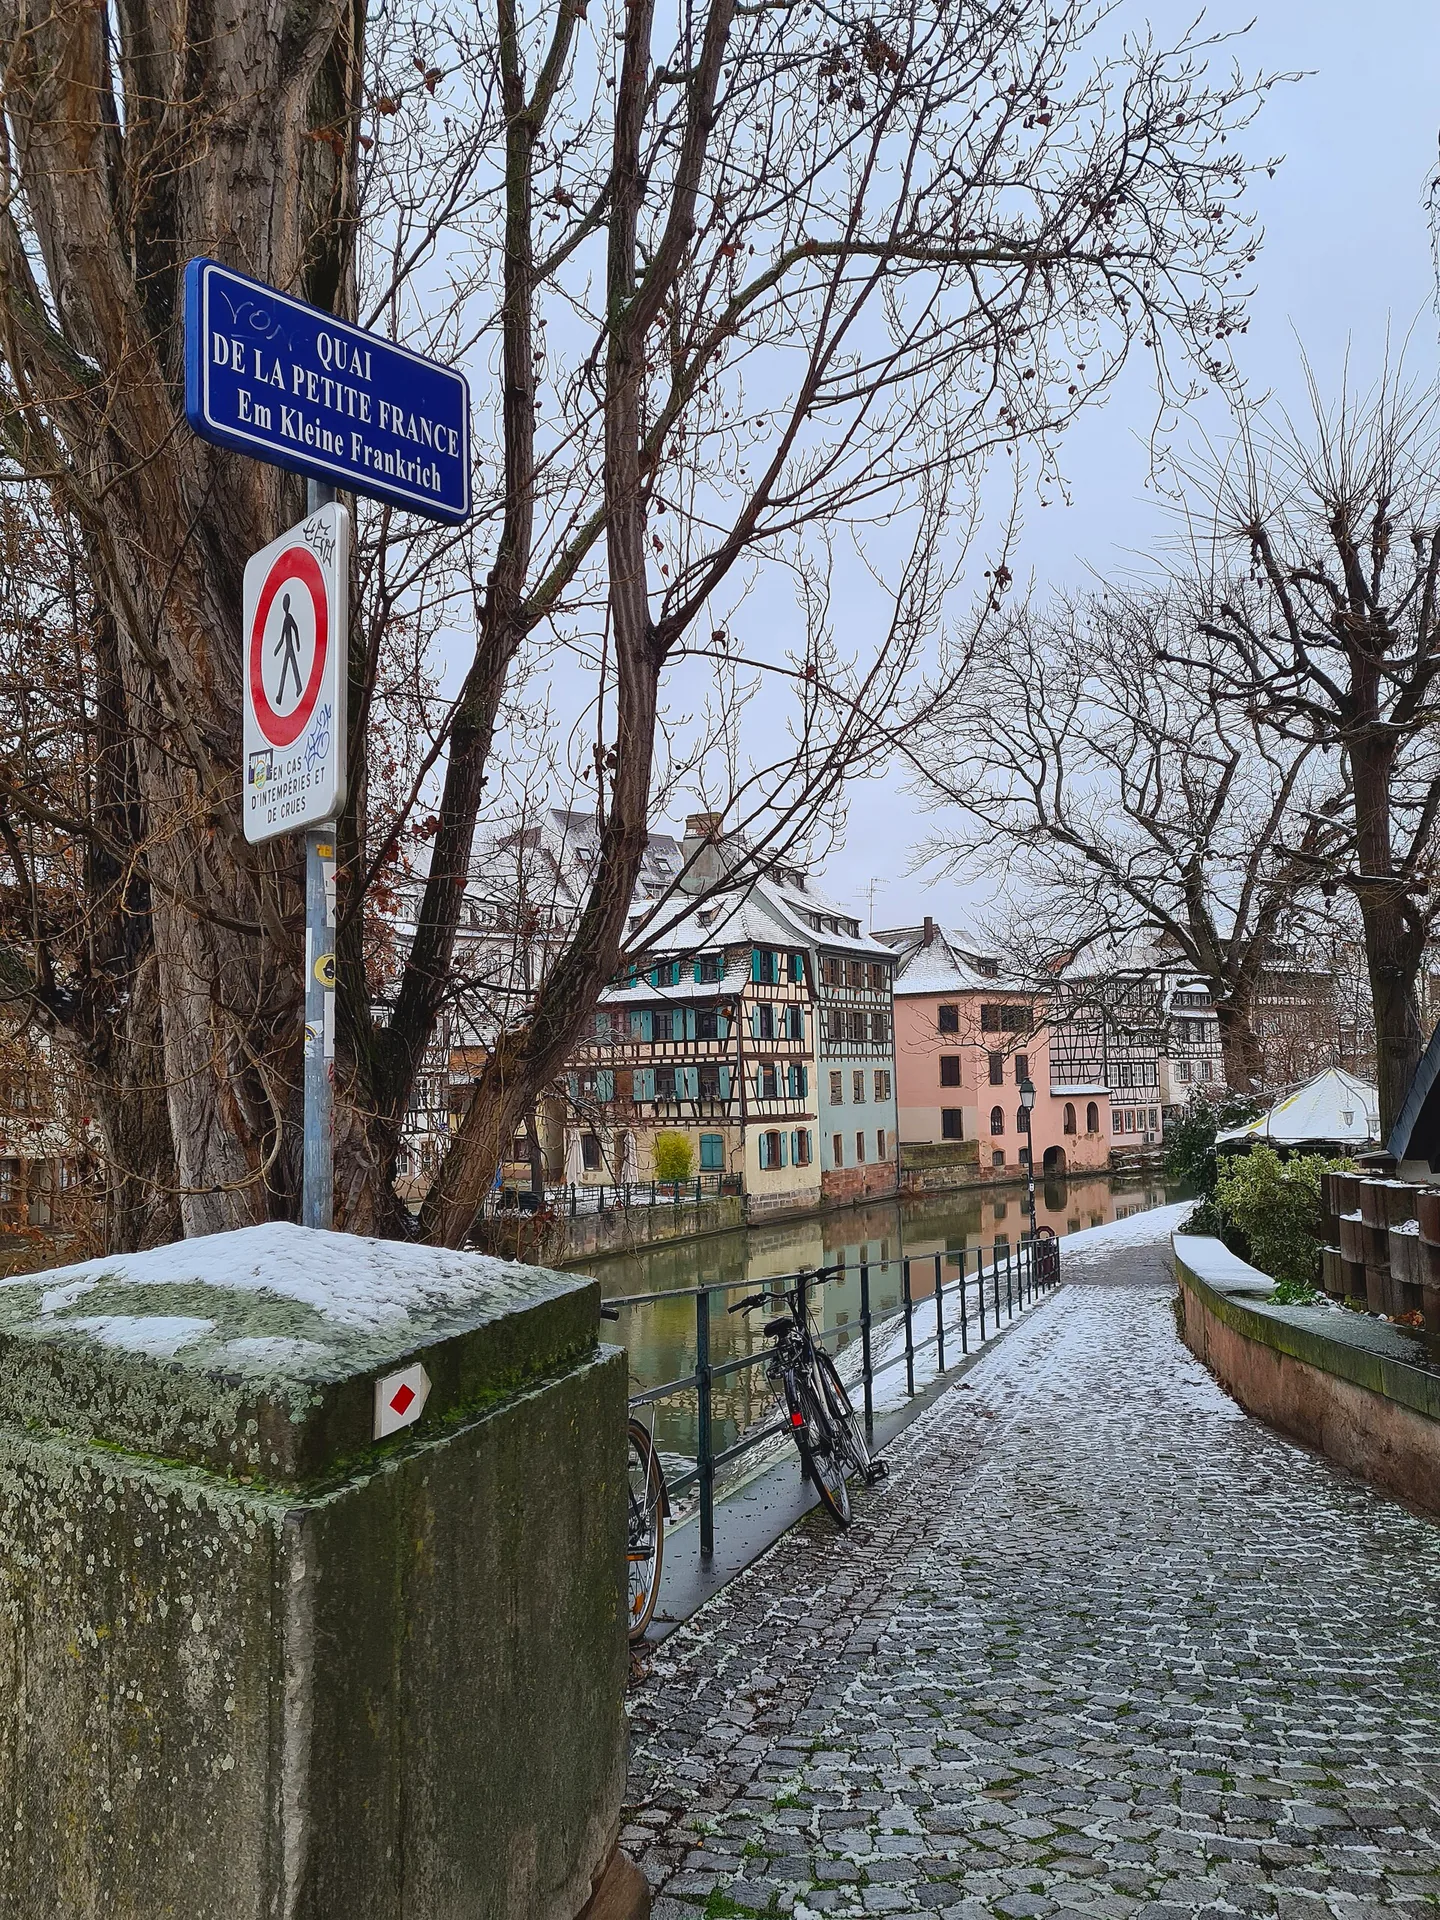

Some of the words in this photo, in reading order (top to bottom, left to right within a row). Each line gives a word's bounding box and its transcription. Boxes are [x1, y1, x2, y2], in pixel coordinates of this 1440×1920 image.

[316, 332, 372, 381] QUAI
[213, 332, 245, 373] DE
[253, 349, 285, 390] LA
[292, 364, 371, 424] PETITE
[378, 399, 459, 458] FRANCE
[237, 388, 272, 431] Em
[280, 405, 344, 456] Kleine
[350, 432, 442, 492] Frankrich
[251, 773, 311, 810] D'INTEMPÉRIES
[315, 767, 325, 785] ET
[273, 764, 283, 781] EN
[286, 756, 302, 776] CAS
[267, 807, 277, 824] DE
[281, 796, 306, 819] CRUES
